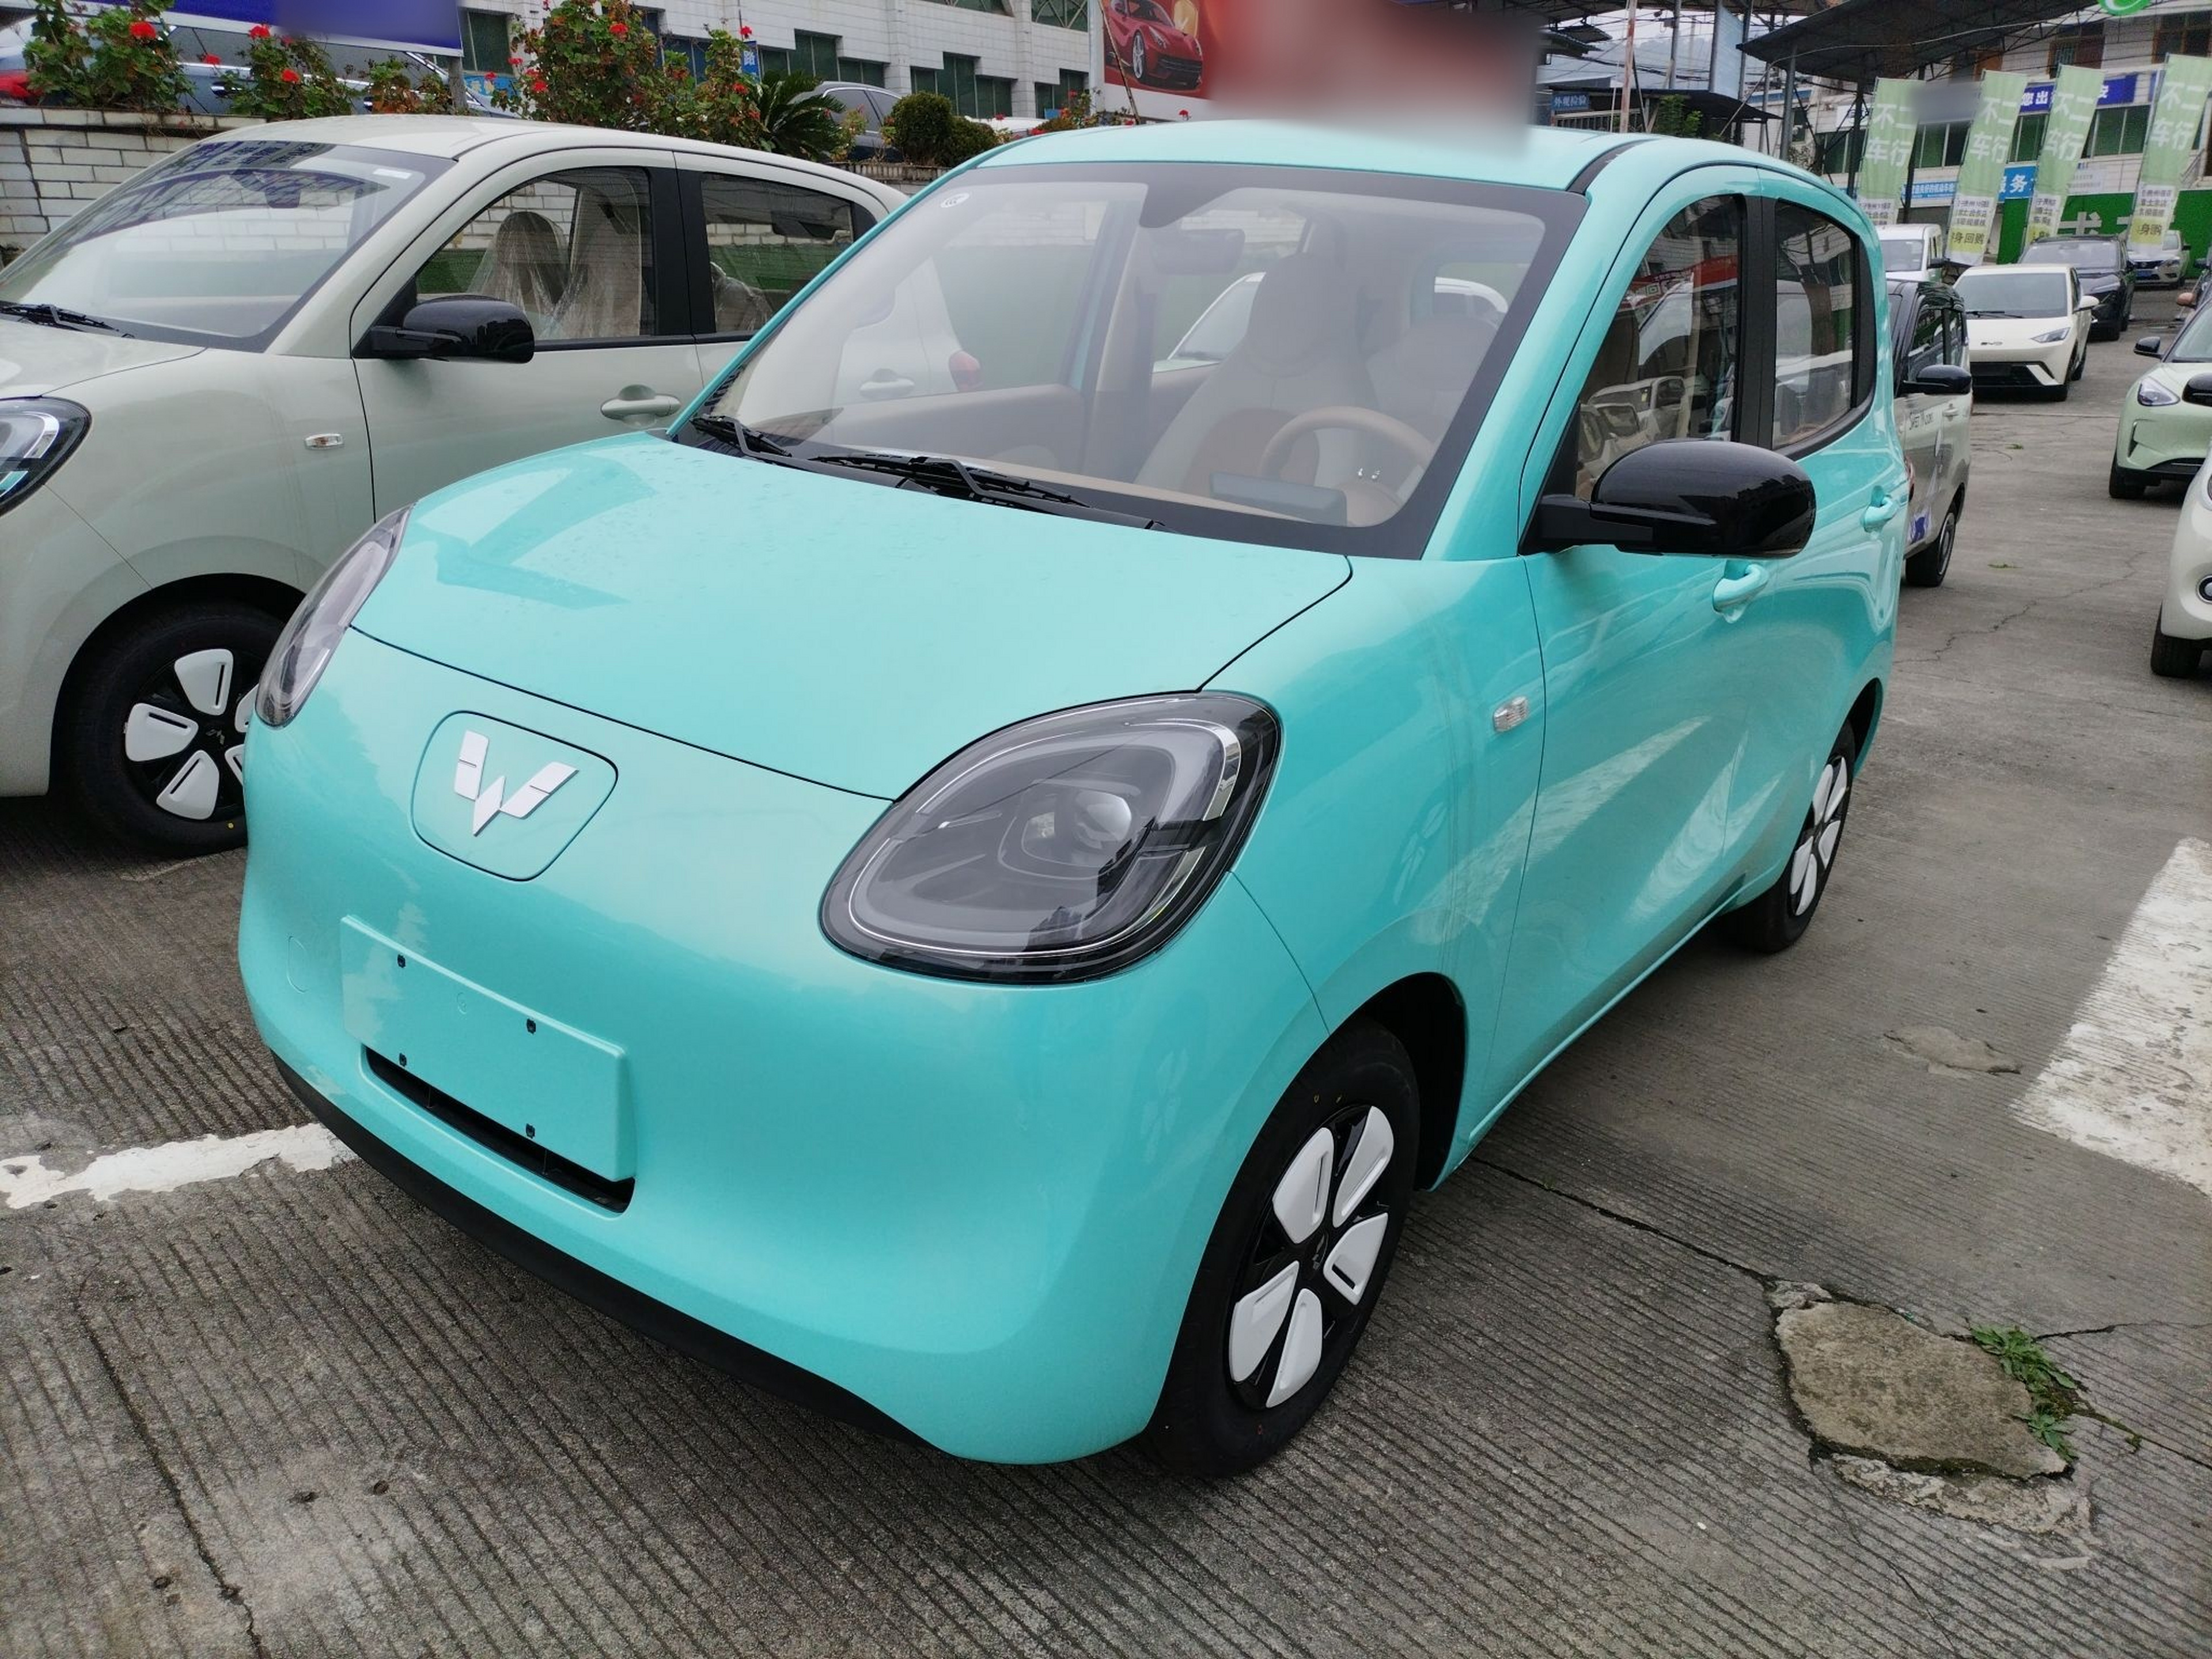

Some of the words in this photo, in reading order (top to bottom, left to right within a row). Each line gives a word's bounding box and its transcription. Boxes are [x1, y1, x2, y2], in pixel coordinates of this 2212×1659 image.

[1980, 97, 2017, 126] 不二
[1969, 131, 2010, 164] 车行
[2149, 118, 2195, 150] 车行
[1865, 137, 1912, 167] 车行
